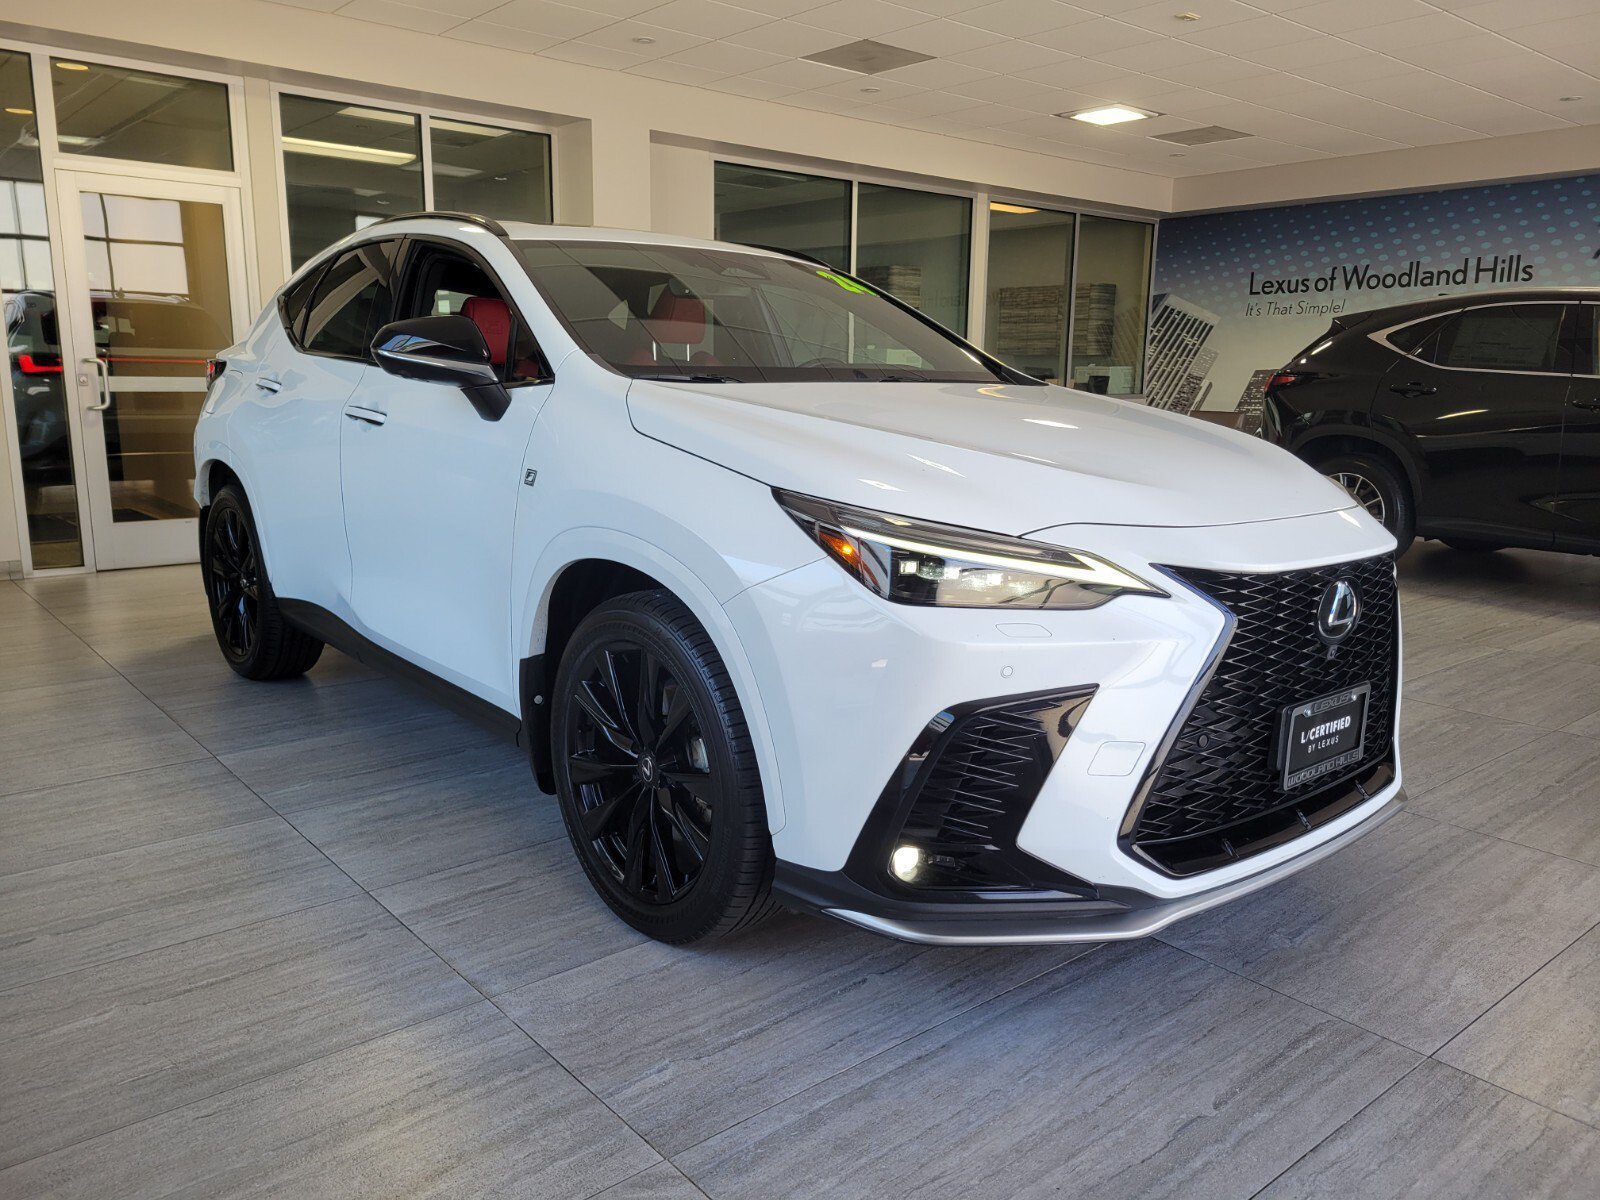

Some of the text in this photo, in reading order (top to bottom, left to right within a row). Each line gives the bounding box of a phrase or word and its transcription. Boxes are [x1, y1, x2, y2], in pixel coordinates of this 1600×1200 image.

[1249, 254, 1534, 296] Lexus of Woodland Hills
[1245, 299, 1346, 318] It's That Simple!
[1313, 694, 1350, 713] LEXUS
[1307, 735, 1340, 754] BY LEXUS
[1287, 751, 1360, 787] WOODLAND HILLS
